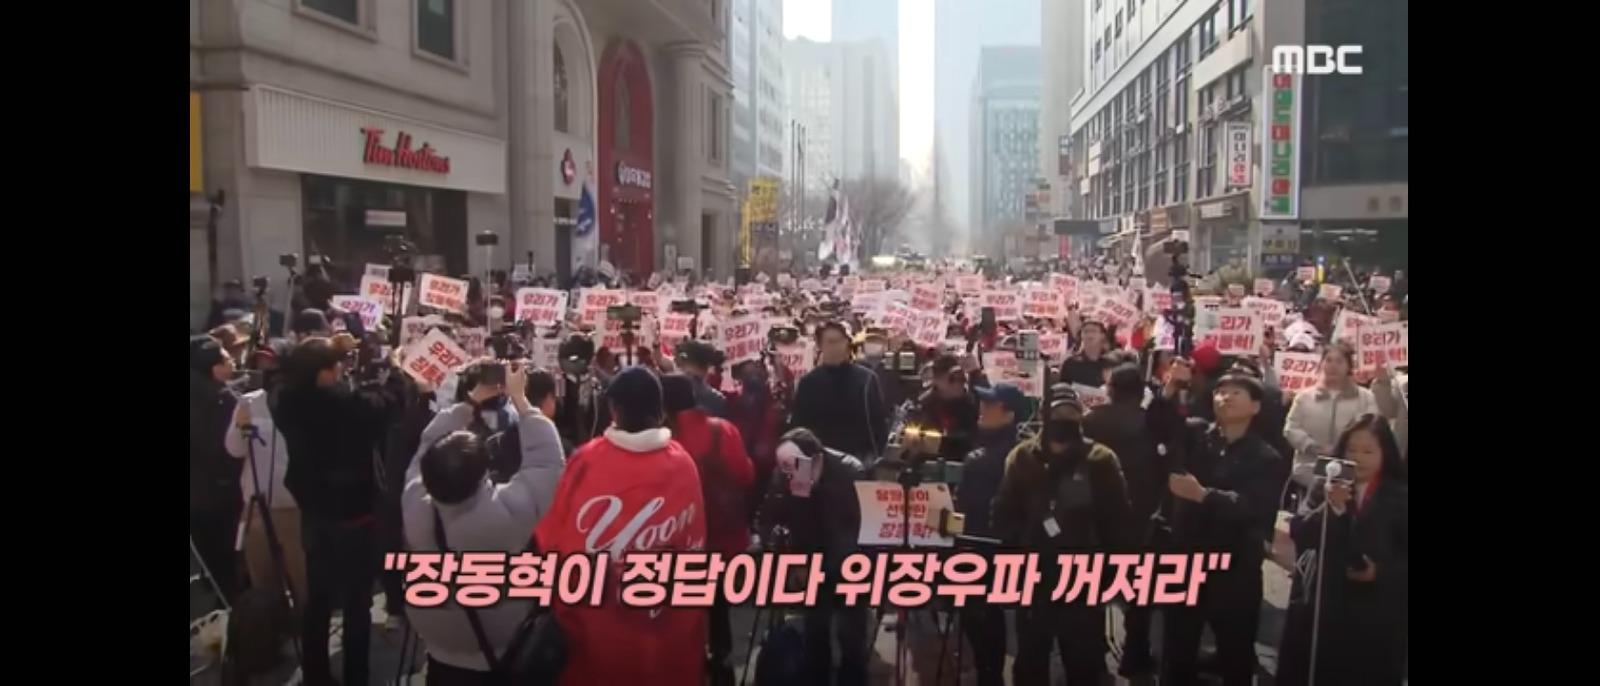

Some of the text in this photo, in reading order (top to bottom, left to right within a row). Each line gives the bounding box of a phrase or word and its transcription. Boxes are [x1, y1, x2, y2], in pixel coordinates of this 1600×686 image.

[361, 127, 449, 174] Tim Hortons
[1220, 315, 1251, 330] 리가
[576, 494, 697, 562] Yoon
